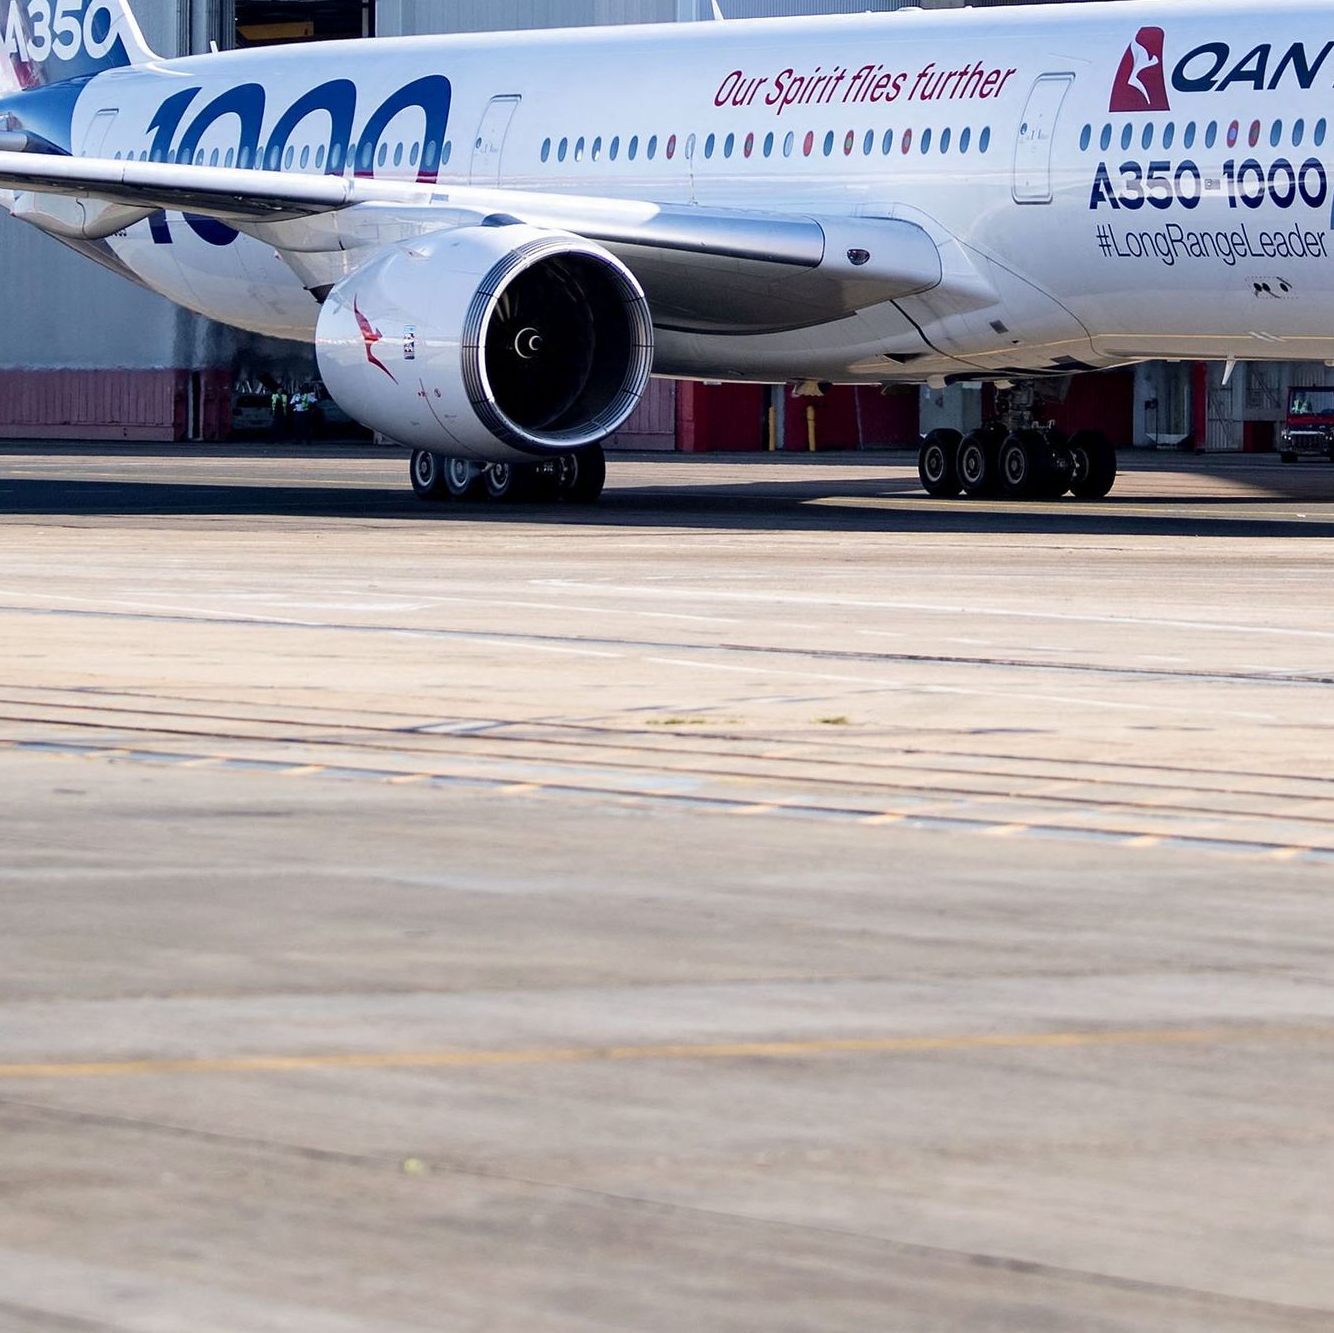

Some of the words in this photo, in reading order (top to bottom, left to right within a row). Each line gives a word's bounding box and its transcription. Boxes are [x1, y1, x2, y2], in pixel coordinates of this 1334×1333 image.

[714, 70, 768, 107] Our
[765, 66, 847, 116] Spirit
[842, 64, 907, 103] flies
[908, 60, 1017, 102] further
[1089, 158, 1328, 210] A350-1000
[1096, 223, 1329, 266] #LongRangeLeader
